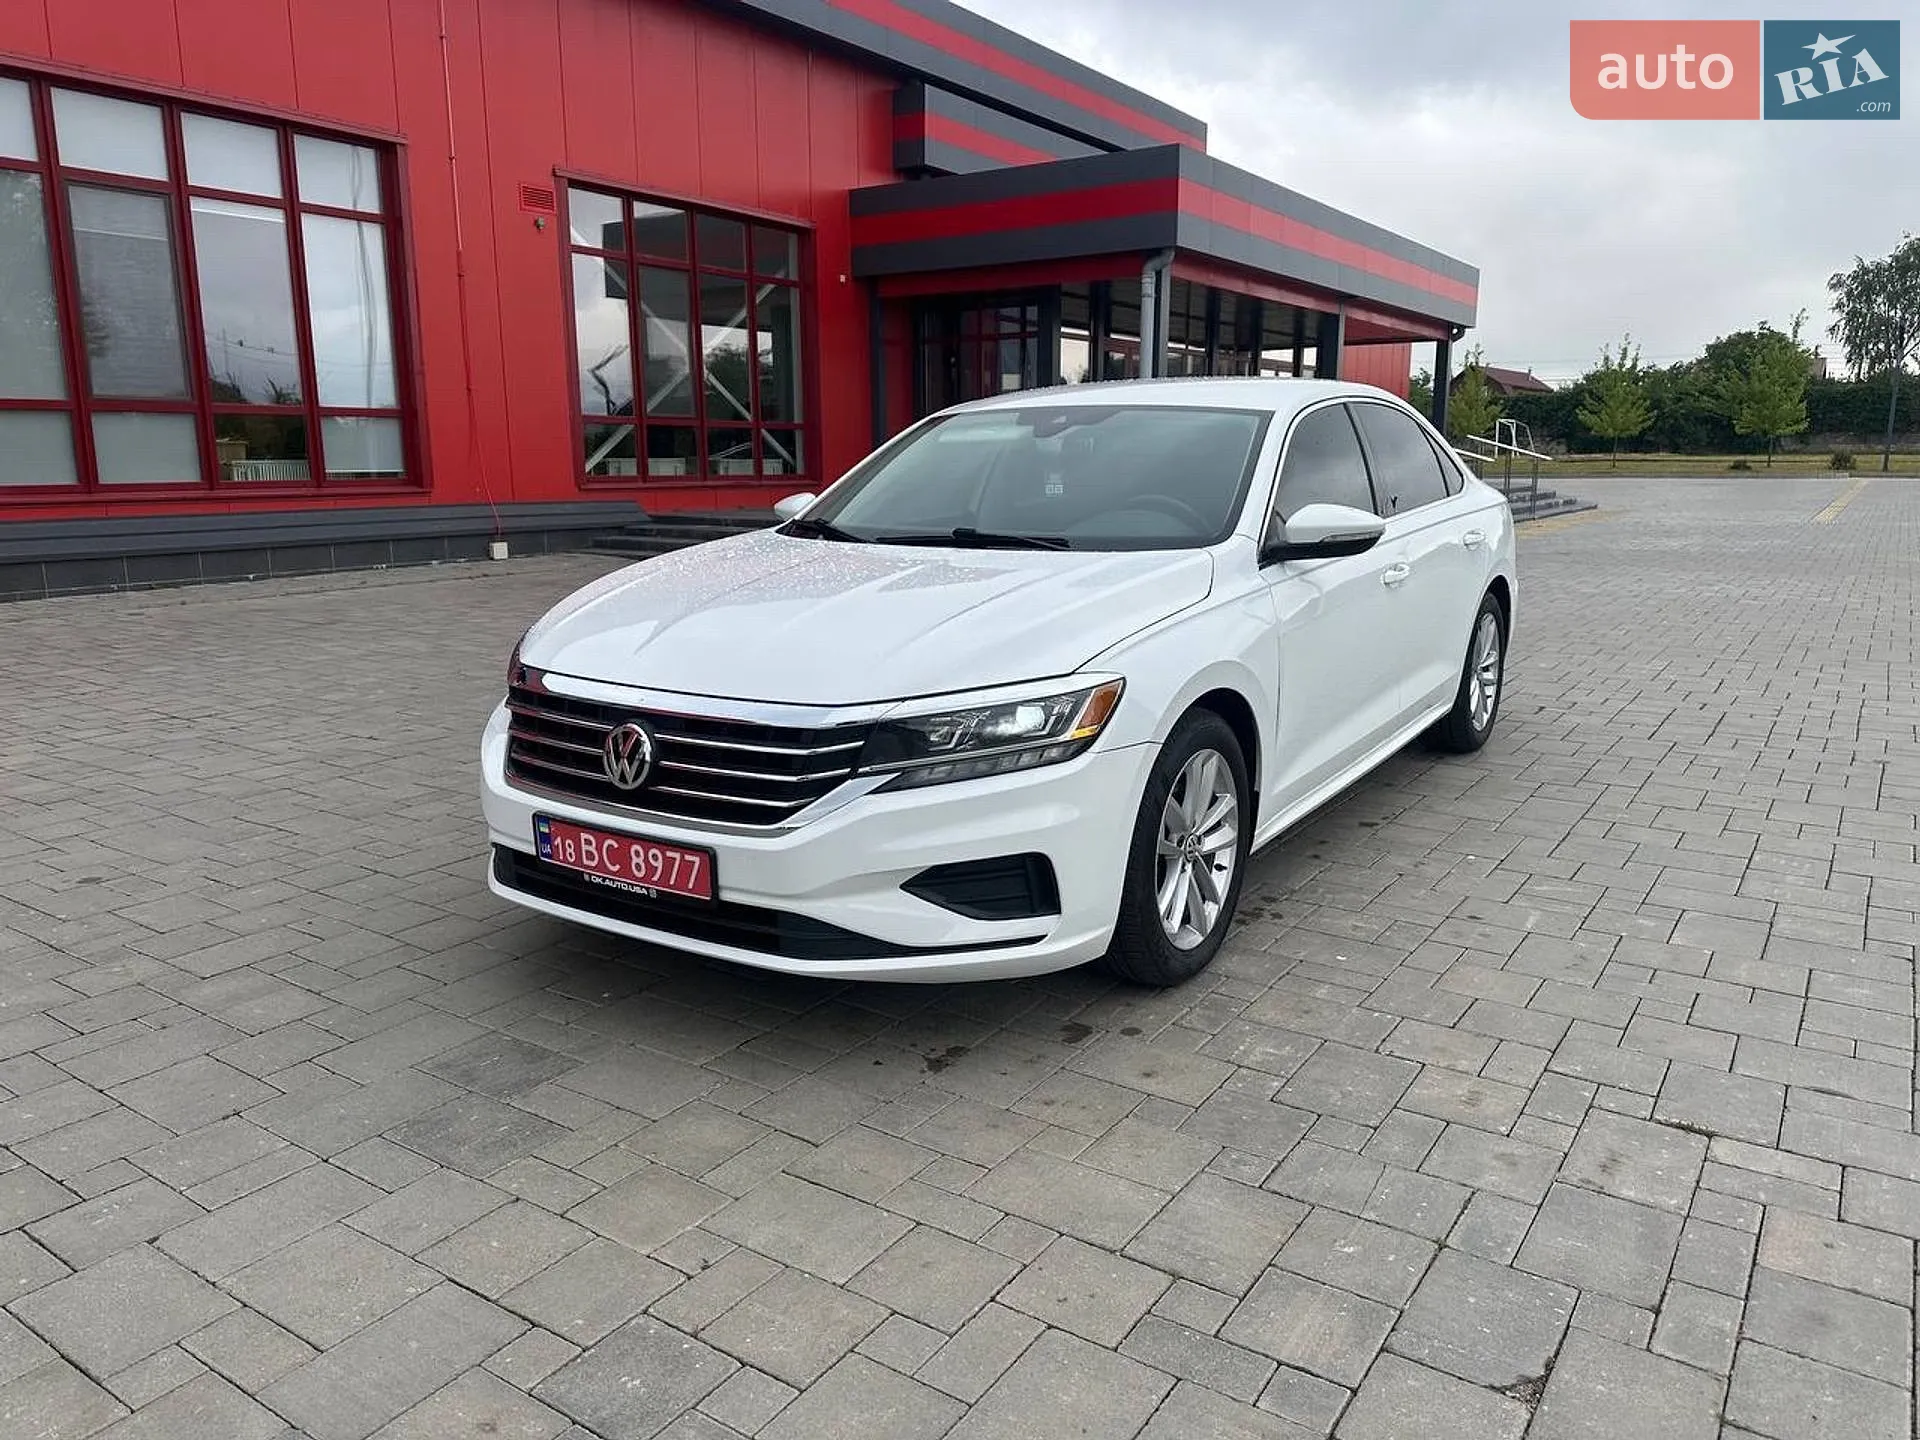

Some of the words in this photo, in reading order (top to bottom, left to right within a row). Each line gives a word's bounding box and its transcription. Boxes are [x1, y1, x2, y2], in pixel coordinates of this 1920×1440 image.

[554, 836, 576, 863] 18
[580, 832, 621, 872] BC
[630, 844, 701, 890] 8977
